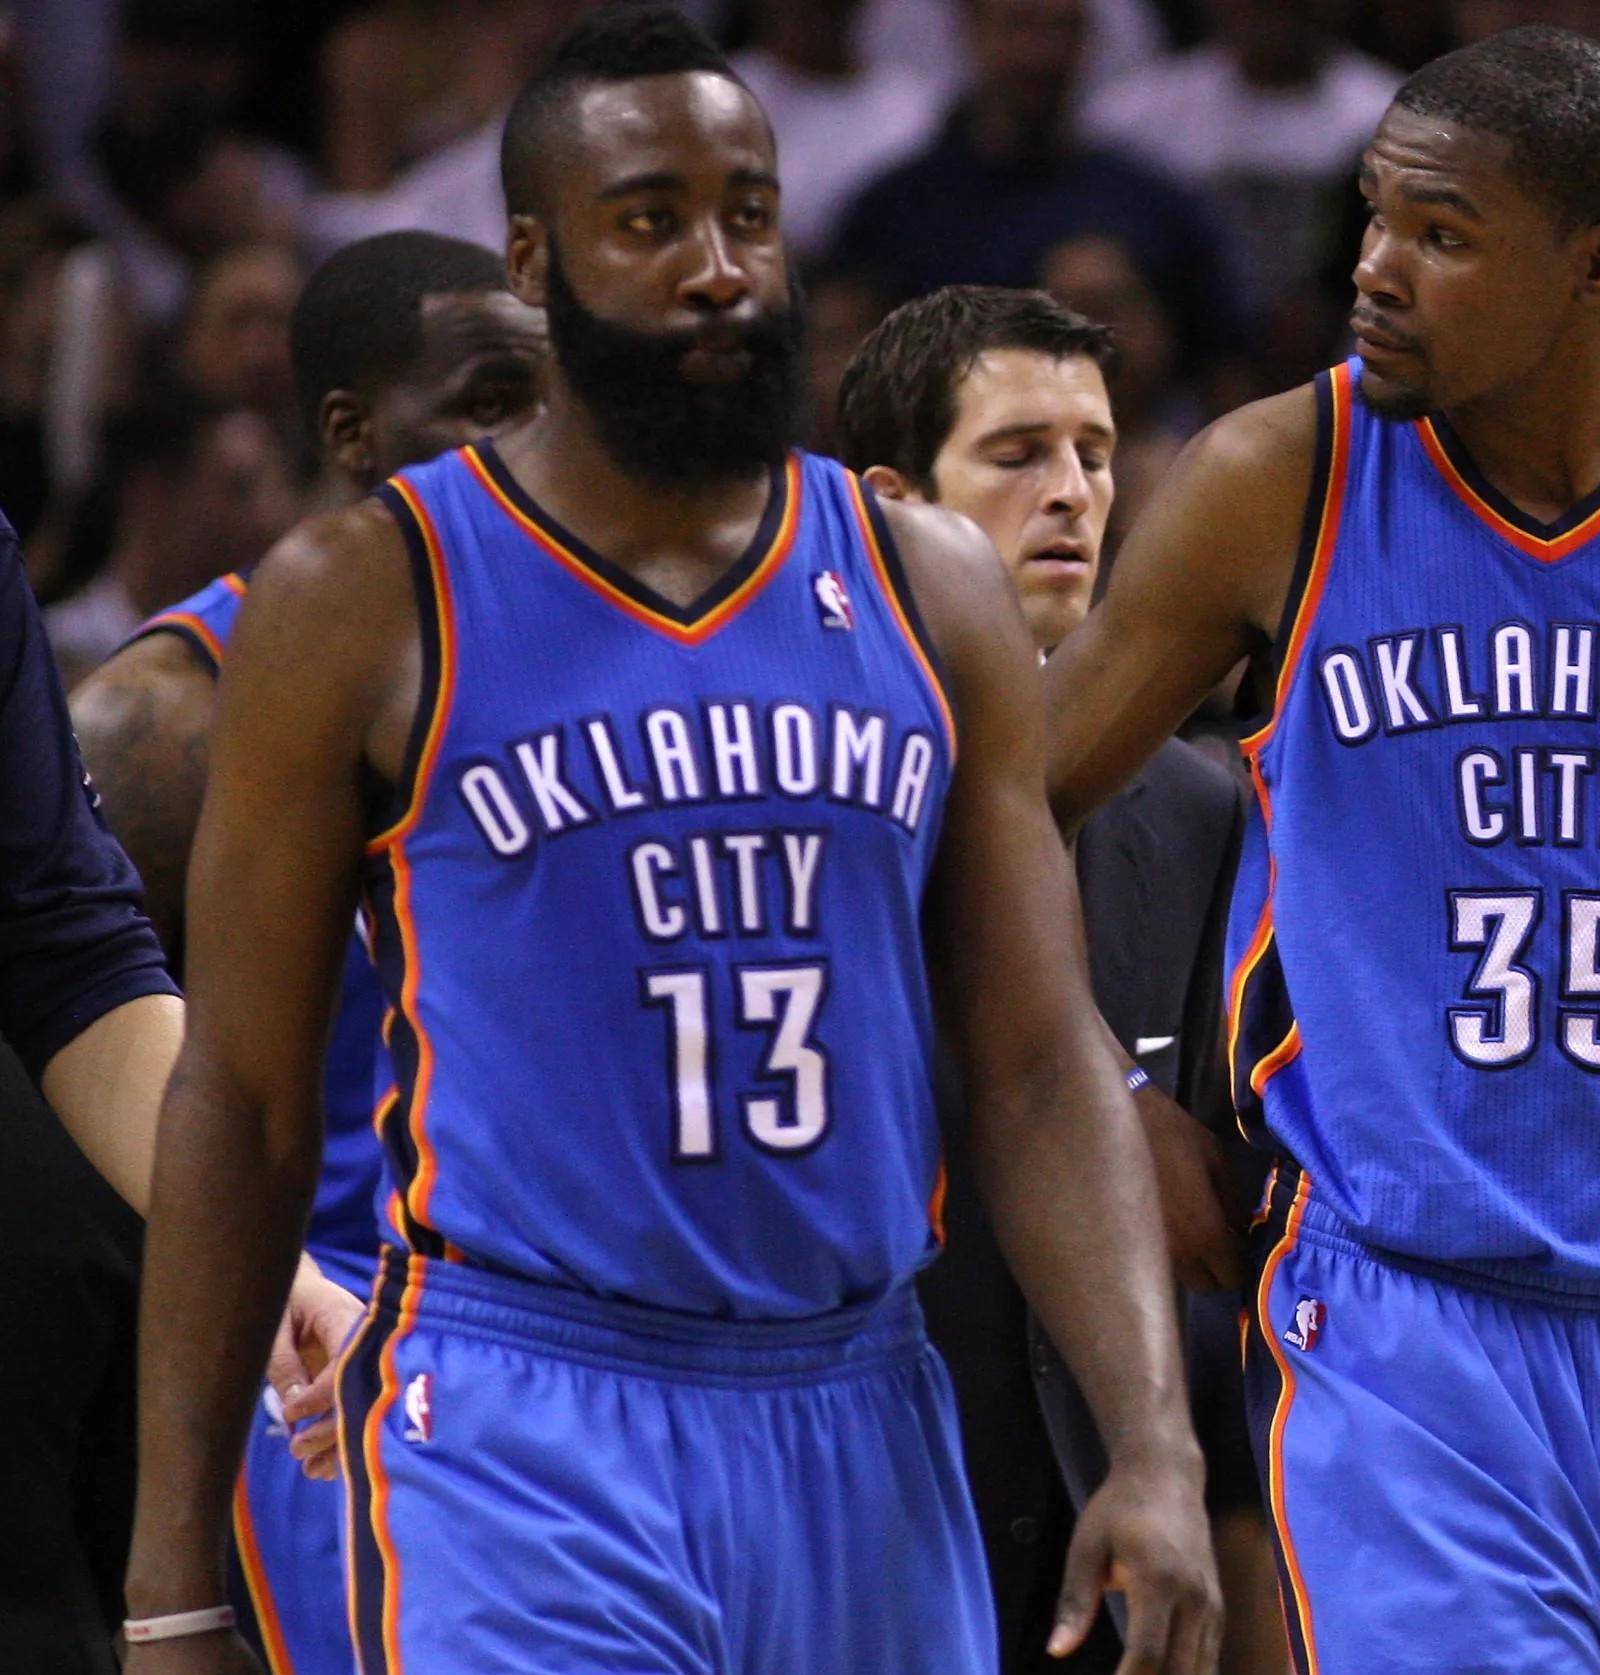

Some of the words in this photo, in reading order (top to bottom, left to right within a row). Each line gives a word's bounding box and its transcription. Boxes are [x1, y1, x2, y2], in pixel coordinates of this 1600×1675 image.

[458, 701, 935, 858] OKLAHOMA
[630, 831, 822, 940] CITY
[644, 964, 829, 1158] 13
